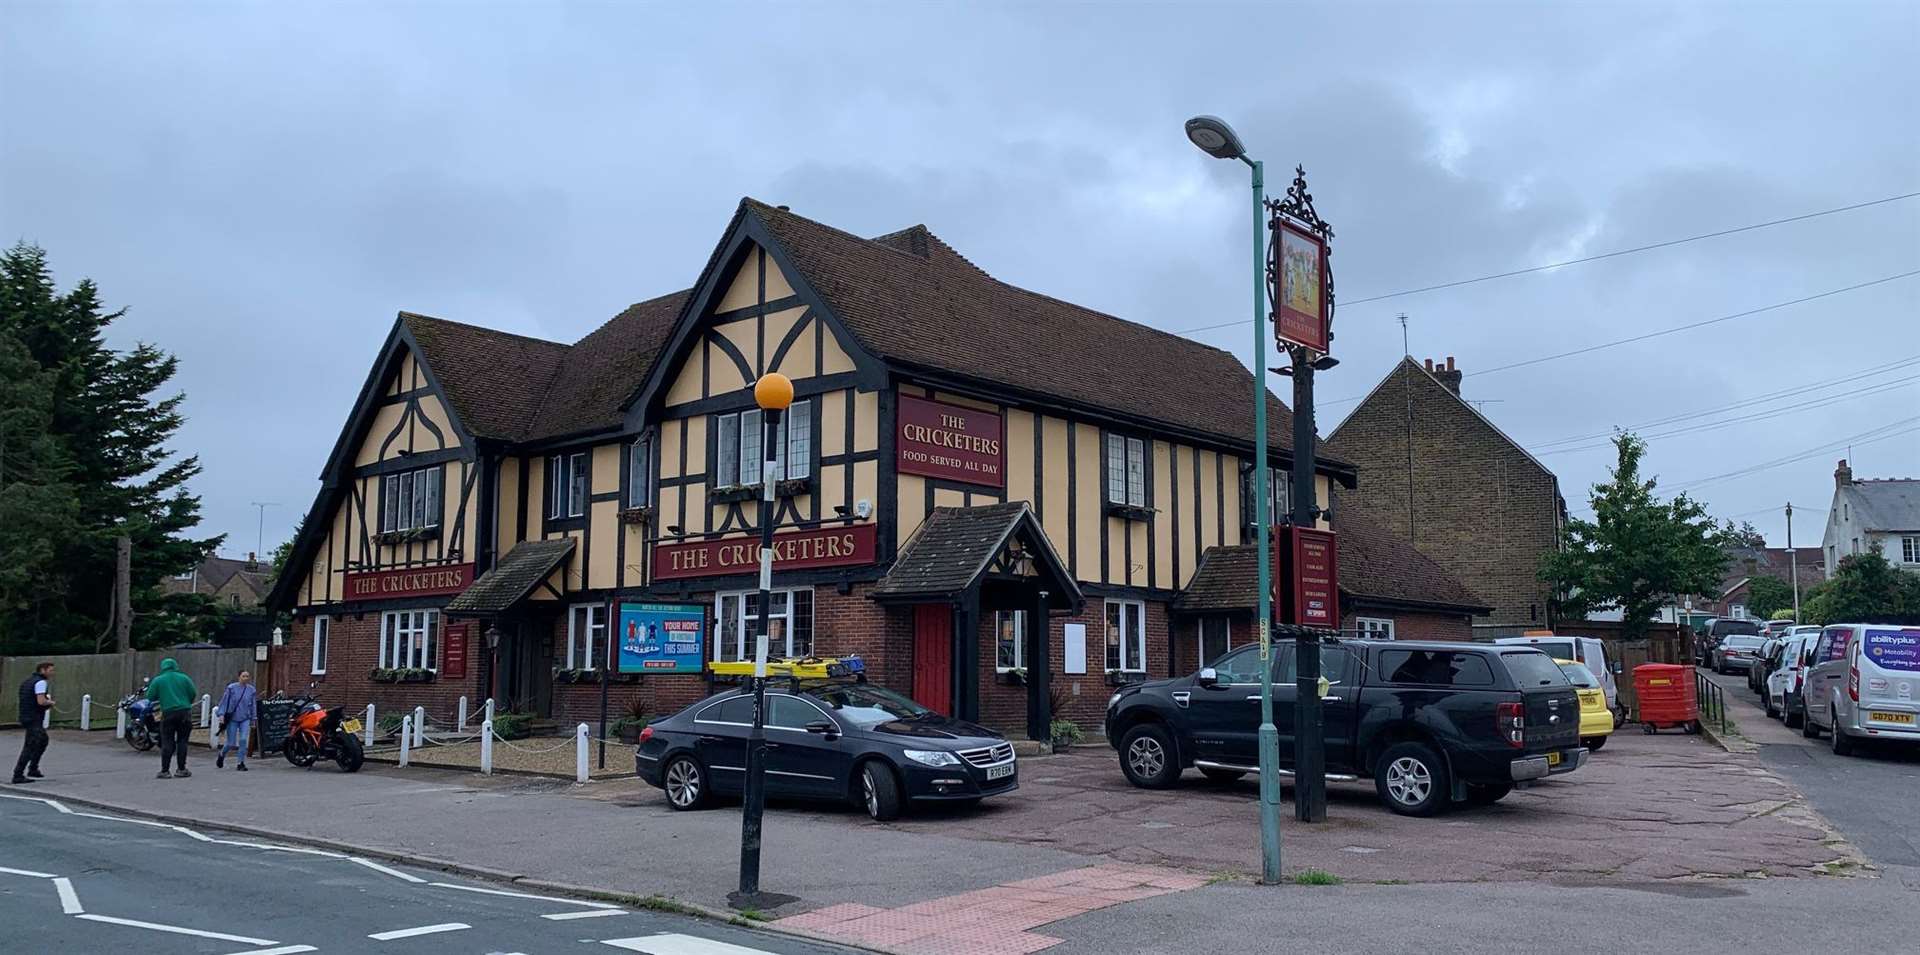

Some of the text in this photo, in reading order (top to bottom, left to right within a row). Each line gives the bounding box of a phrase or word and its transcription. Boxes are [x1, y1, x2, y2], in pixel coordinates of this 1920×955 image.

[941, 414, 965, 429] THE
[903, 423, 999, 455] CRICKETERS
[903, 450, 998, 474] FOOD SERVED ALL DAY
[670, 548, 708, 570] THE
[354, 570, 462, 594] THE CRICKETERS
[664, 621, 699, 630] YOUR HOME
[664, 643, 700, 654] THIS SUMMER
[1871, 636, 1916, 645] abilityplus
